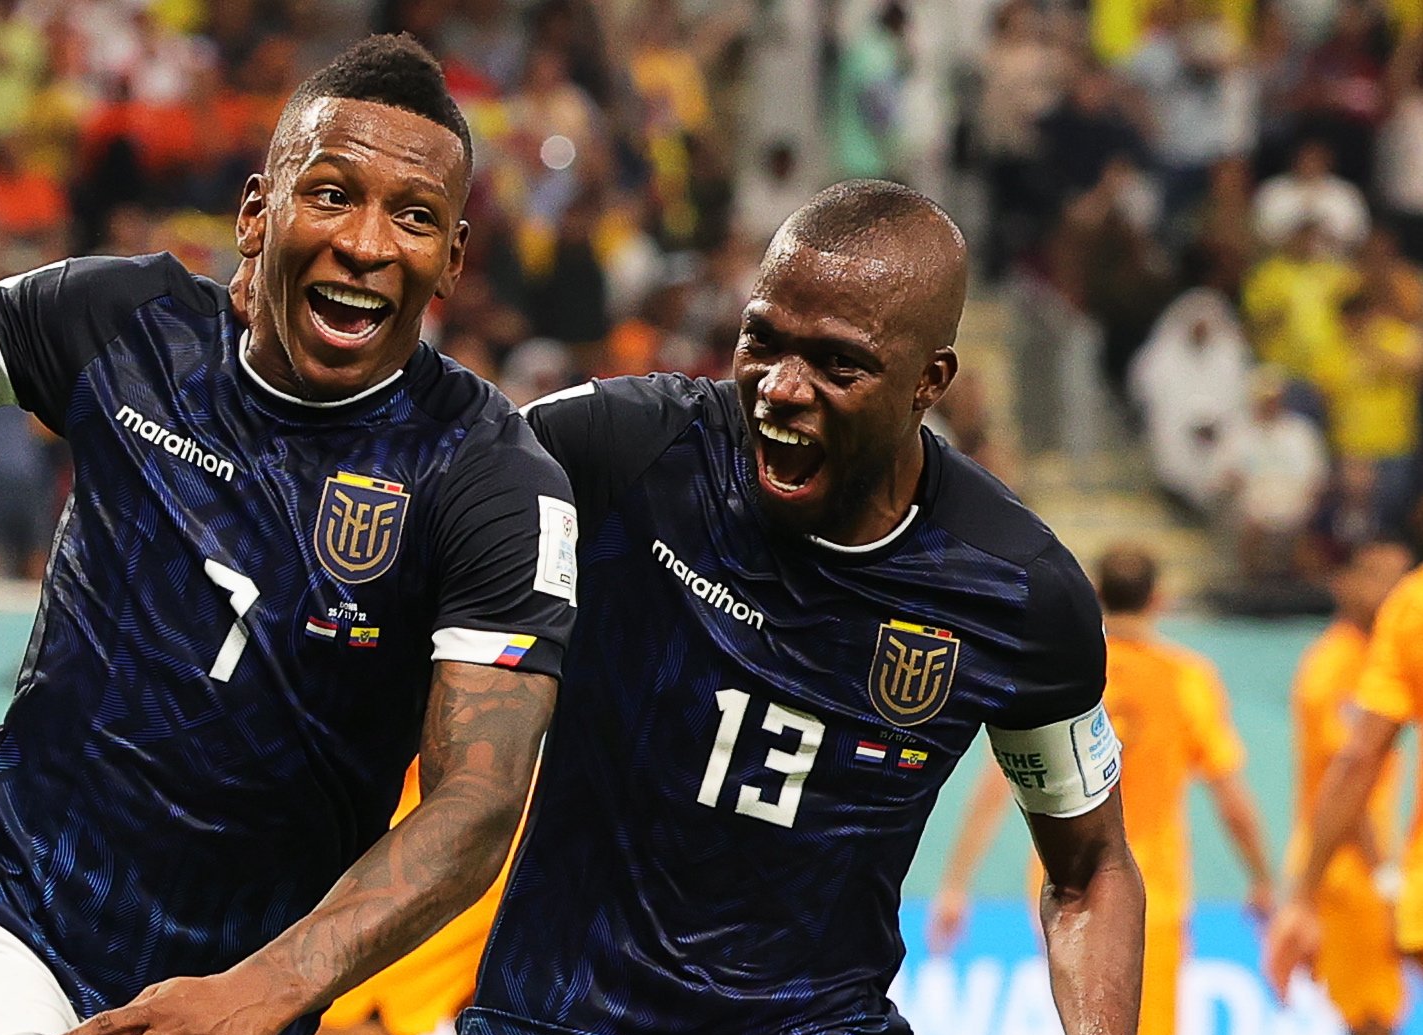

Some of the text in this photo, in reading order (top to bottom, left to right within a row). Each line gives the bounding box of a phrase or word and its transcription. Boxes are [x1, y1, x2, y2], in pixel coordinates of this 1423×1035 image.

[117, 404, 235, 483] marathon
[204, 557, 261, 683] 7
[652, 539, 764, 631] marathon
[697, 688, 826, 828] 13
[1001, 751, 1044, 768] THE
